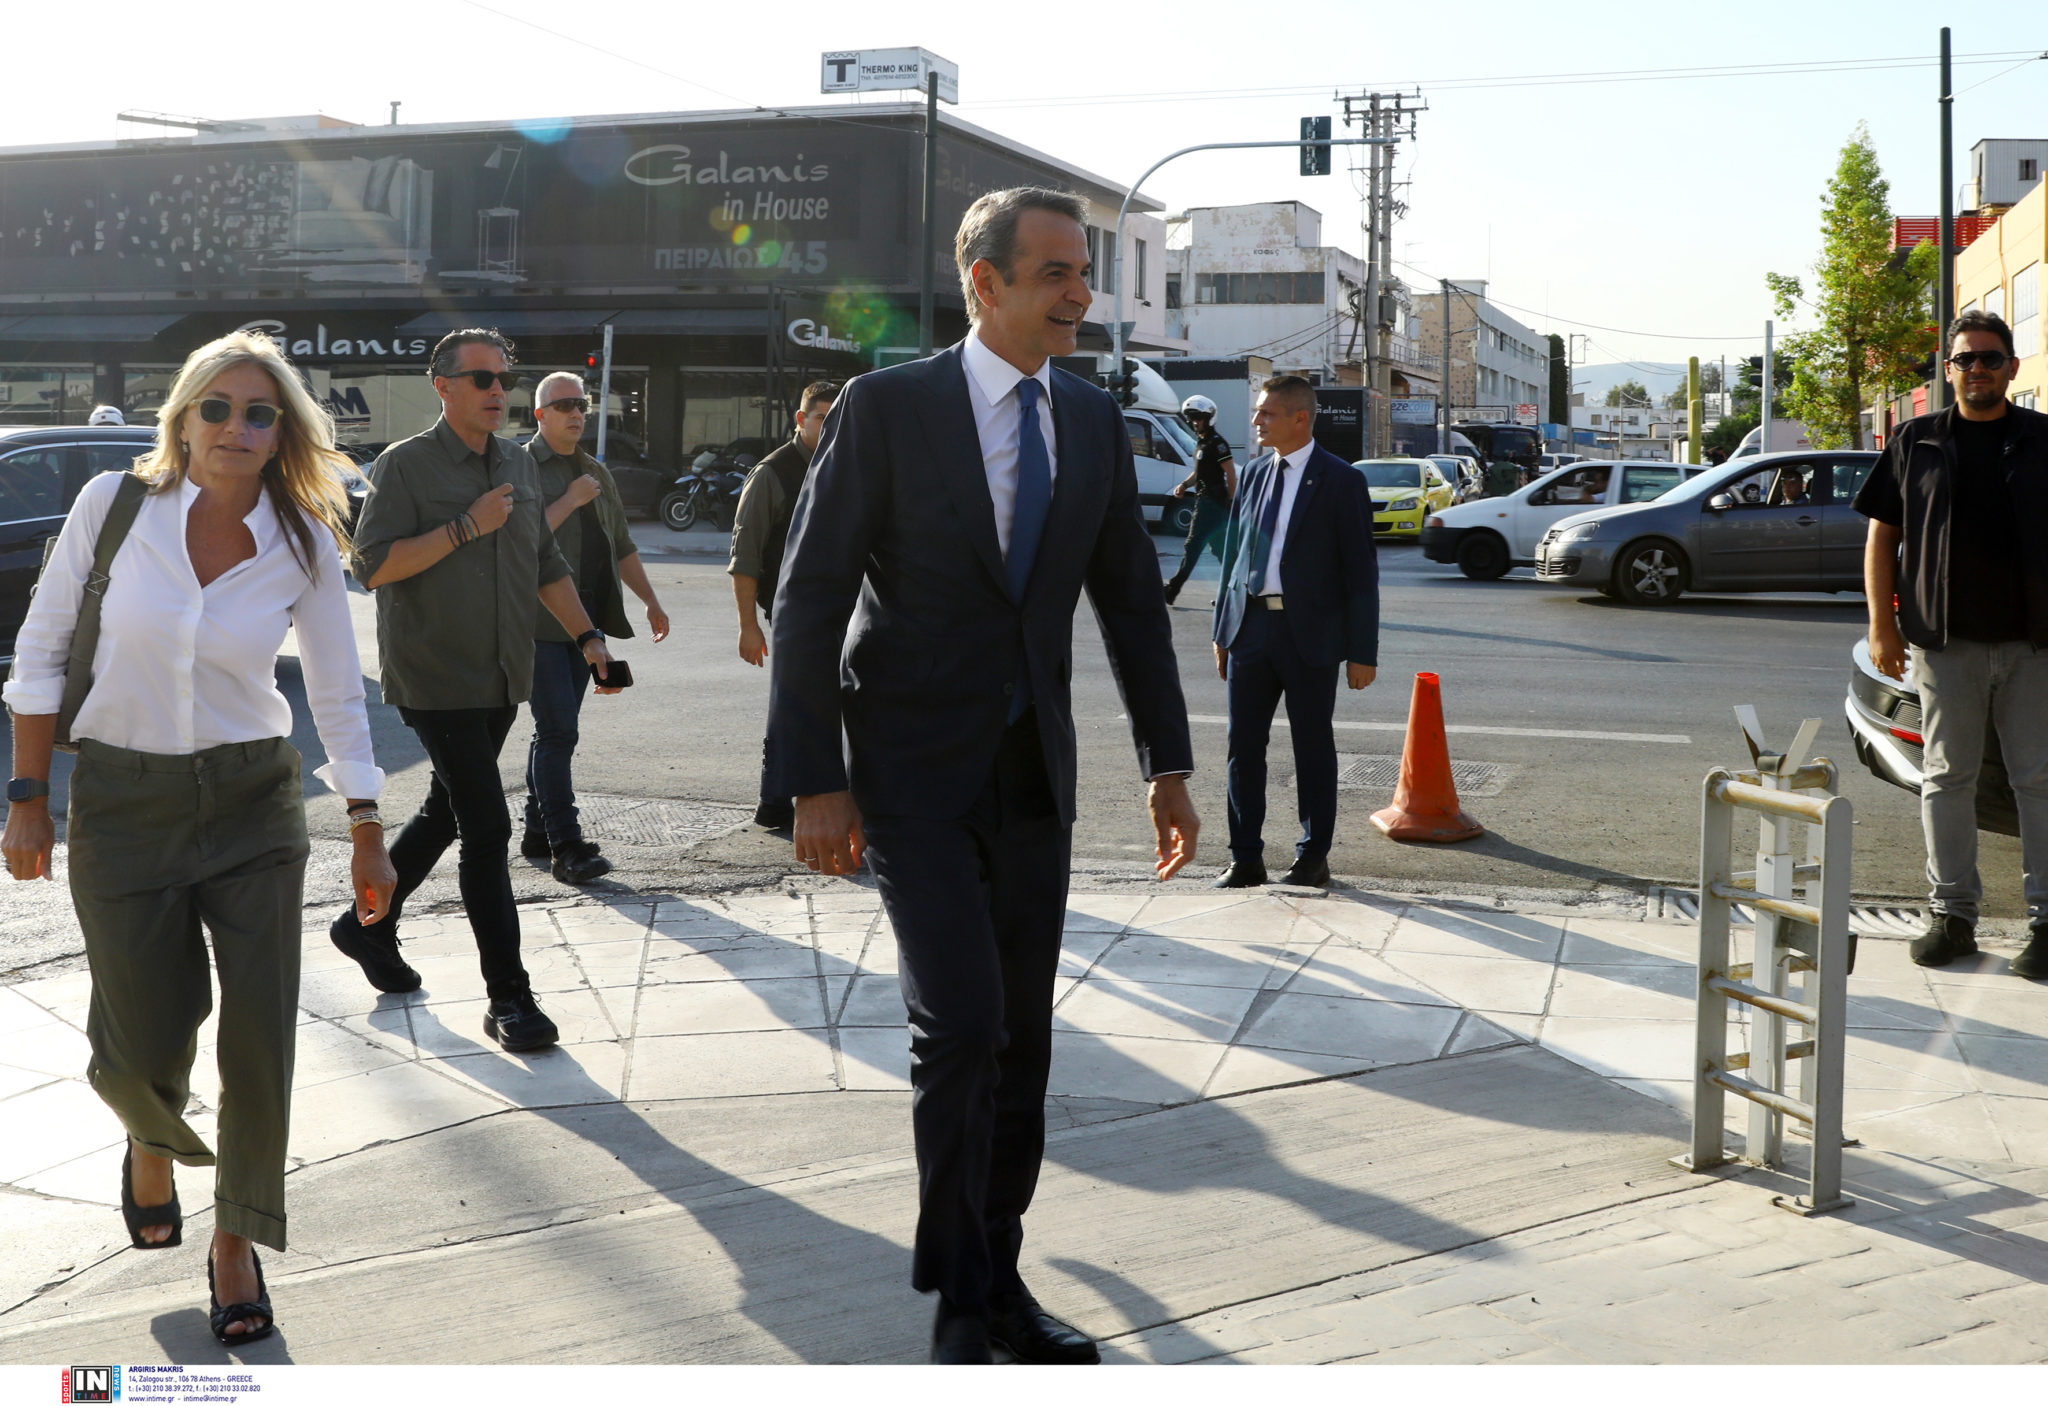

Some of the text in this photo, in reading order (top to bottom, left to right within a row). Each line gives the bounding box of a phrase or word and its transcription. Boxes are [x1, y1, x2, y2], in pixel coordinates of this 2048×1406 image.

[827, 59, 856, 82] T
[862, 64, 918, 74] THERMO KING
[624, 144, 829, 186] Galanis
[721, 191, 829, 221] in House
[779, 240, 828, 274] 45
[786, 318, 861, 354] Galanis
